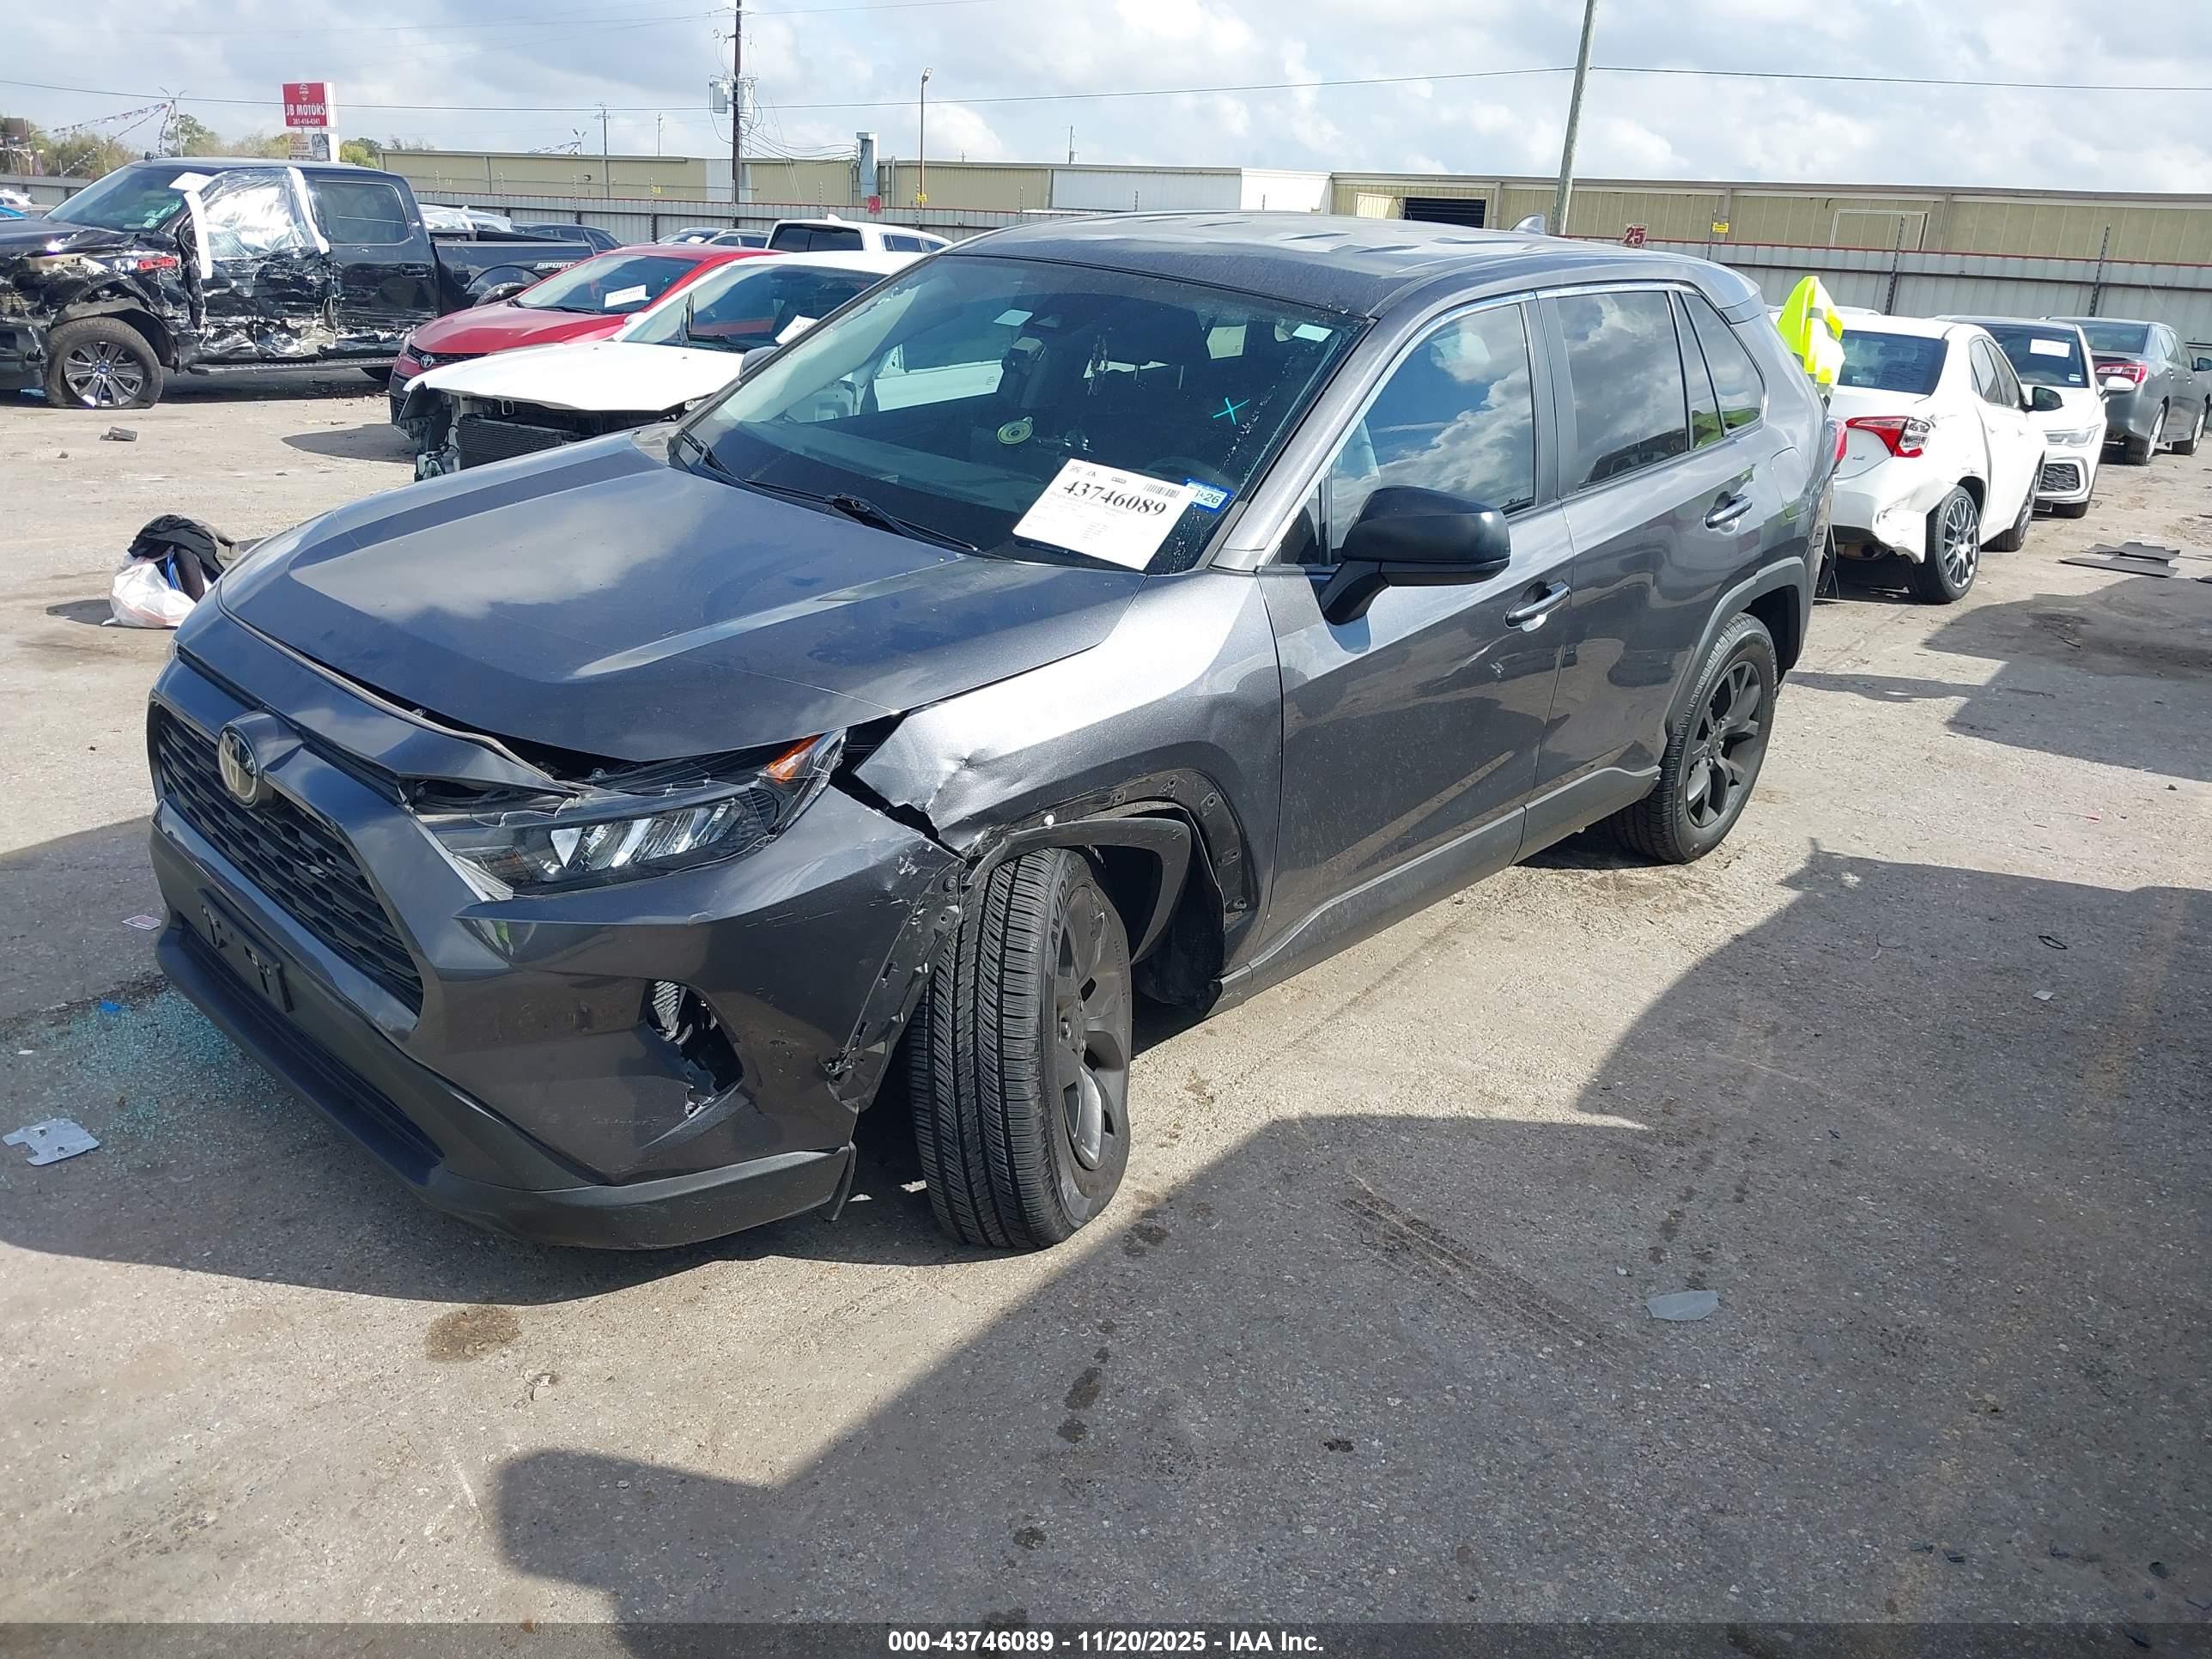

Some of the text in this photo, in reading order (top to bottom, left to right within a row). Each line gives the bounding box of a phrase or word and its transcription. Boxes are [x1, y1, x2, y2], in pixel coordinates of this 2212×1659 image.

[287, 104, 325, 116] JB MOTORS
[1623, 227, 1645, 245] 25
[1063, 480, 1168, 516] 43746089
